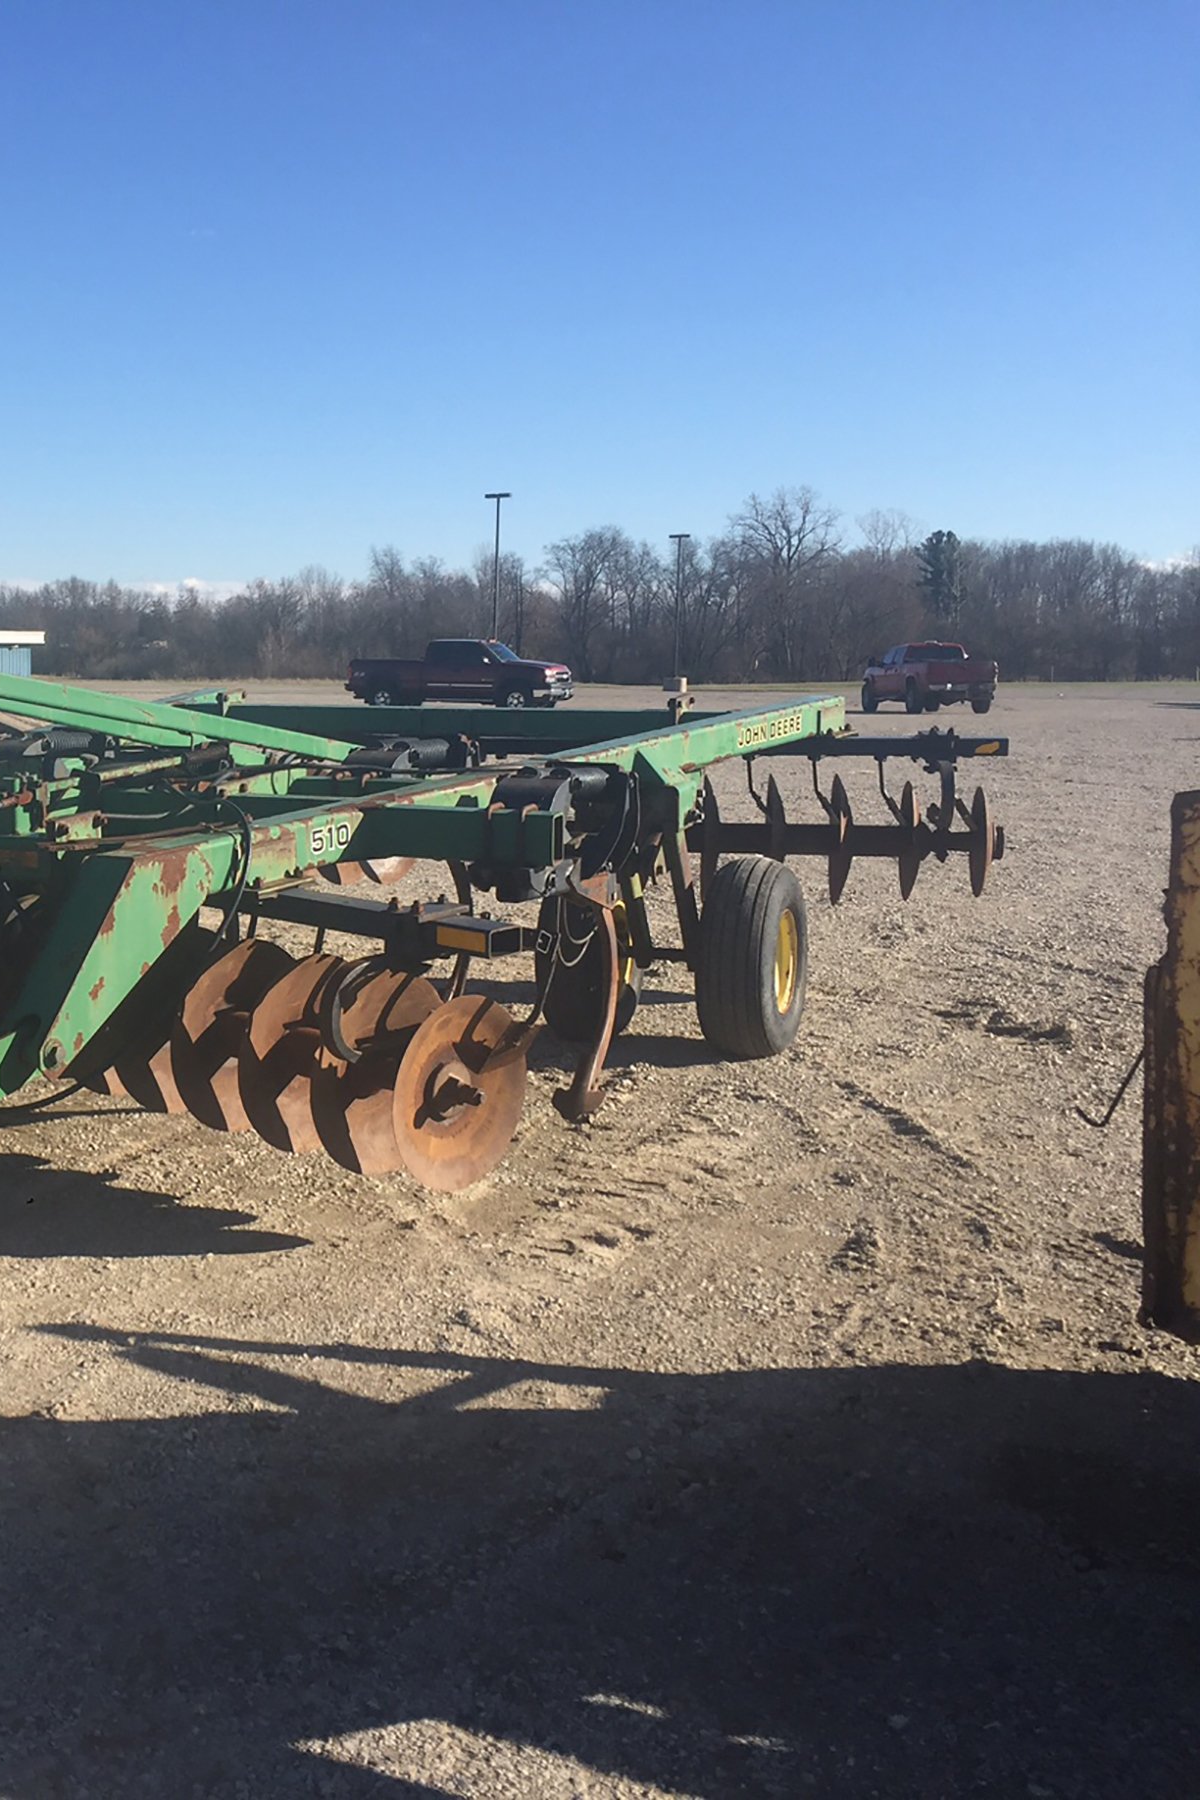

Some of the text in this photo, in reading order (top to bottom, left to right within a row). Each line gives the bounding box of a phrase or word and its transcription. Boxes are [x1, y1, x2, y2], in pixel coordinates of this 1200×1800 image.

[738, 715, 802, 747] JOHN DEERE
[311, 823, 350, 854] 510
